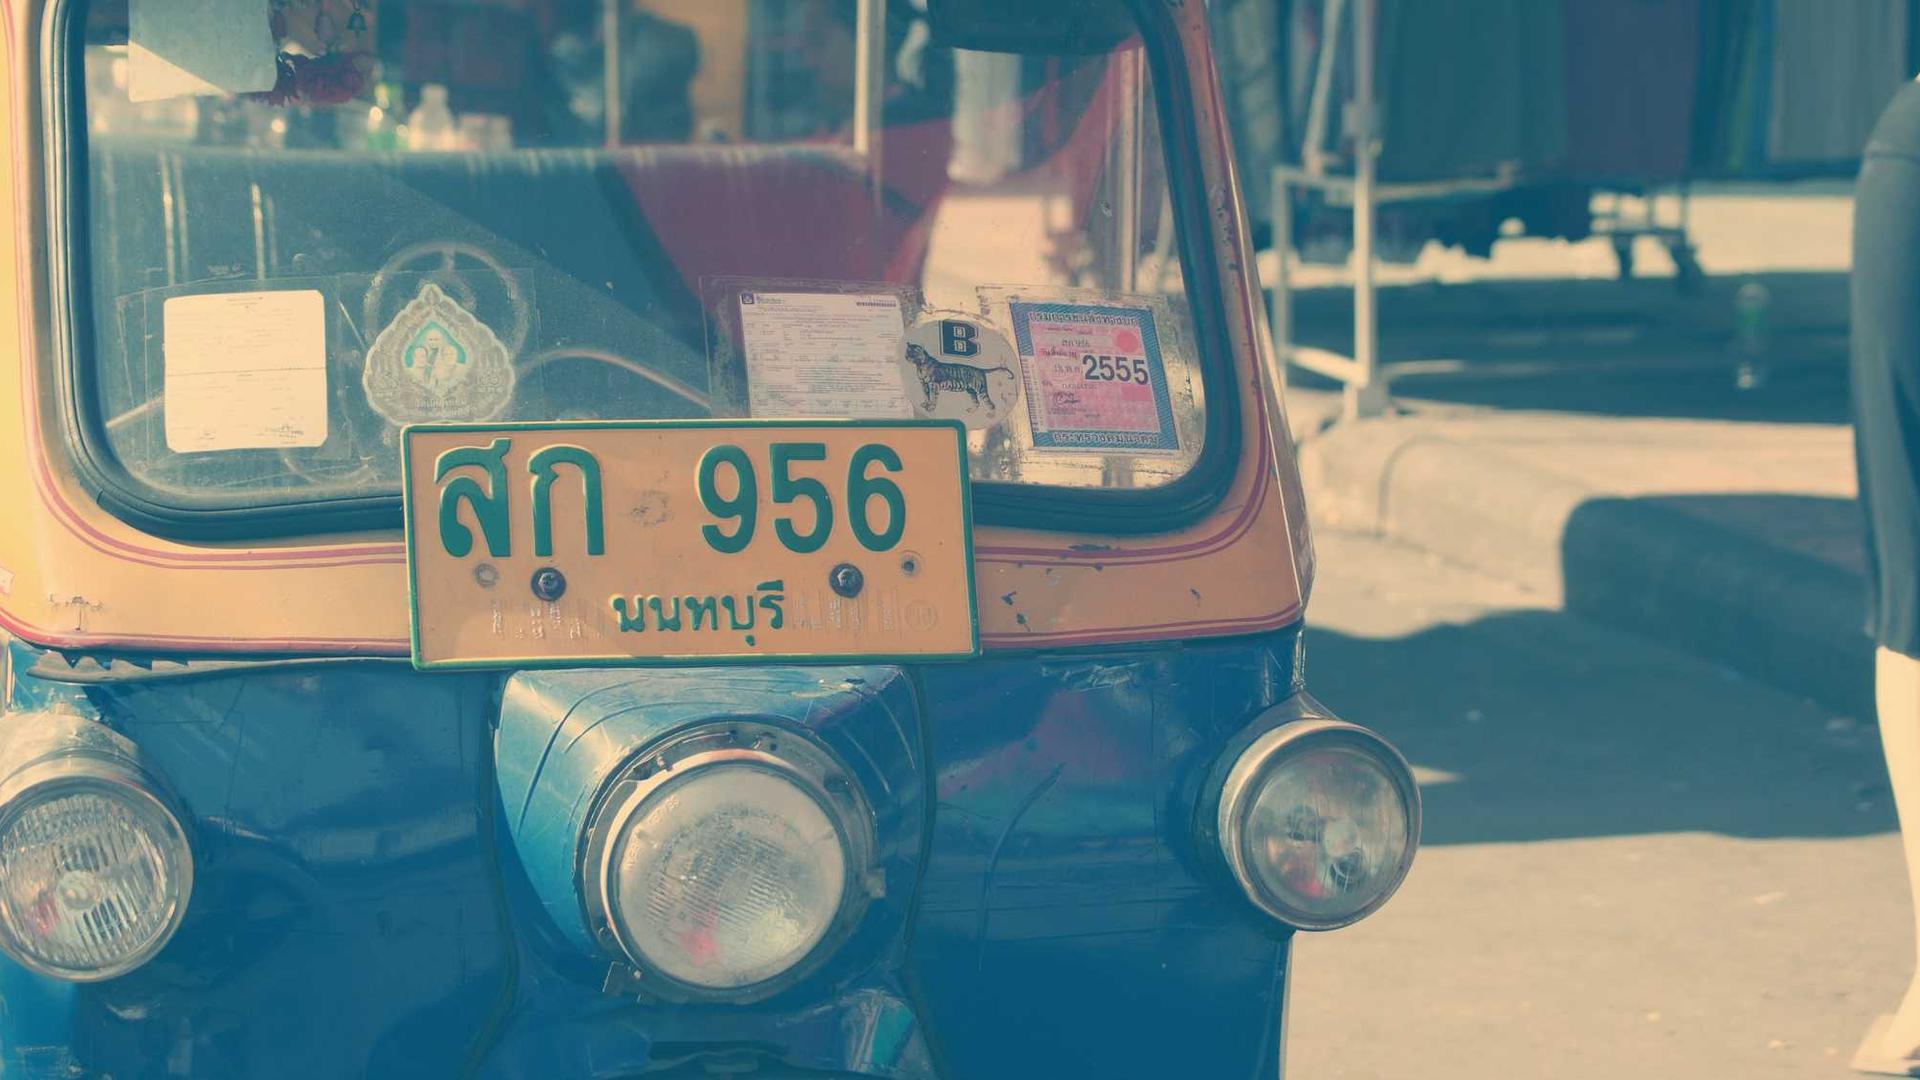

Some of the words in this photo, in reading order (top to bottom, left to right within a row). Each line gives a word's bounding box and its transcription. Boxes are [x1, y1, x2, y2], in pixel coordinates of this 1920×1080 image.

[940, 319, 980, 358] B
[1082, 355, 1148, 385] 2555
[436, 438, 604, 557] สก
[699, 443, 907, 554] 956
[612, 579, 784, 647] นนทบุรี
